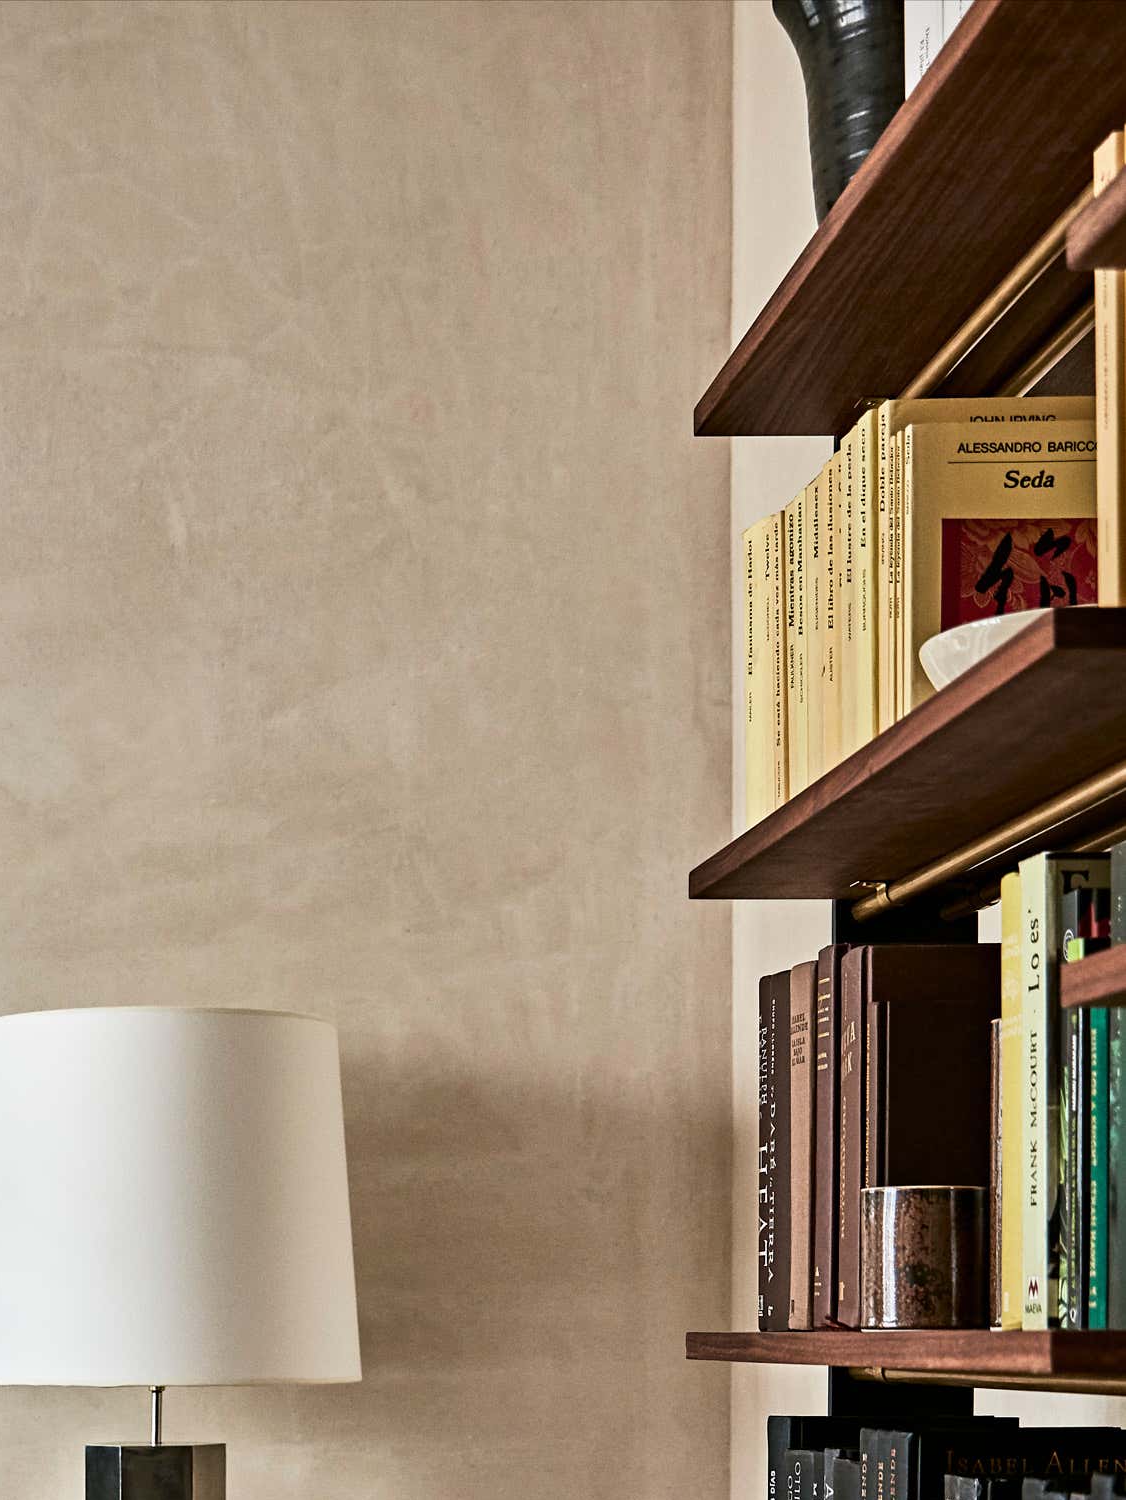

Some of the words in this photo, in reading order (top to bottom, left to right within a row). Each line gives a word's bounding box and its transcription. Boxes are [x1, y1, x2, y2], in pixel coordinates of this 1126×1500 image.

[956, 440, 1042, 454] ALESSANDRO
[845, 443, 853, 480] perla
[1004, 469, 1056, 489] Seda
[846, 501, 852, 518] de
[860, 511, 866, 524] el
[860, 527, 866, 548] En
[827, 559, 834, 576] de
[846, 568, 852, 583] El
[797, 576, 803, 592] en
[827, 614, 834, 629] El
[1029, 1028, 1038, 1129] McCOURT
[1029, 1139, 1038, 1209] FRANK
[759, 1142, 768, 1267] HEAT
[945, 1449, 1027, 1473] ISABEL
